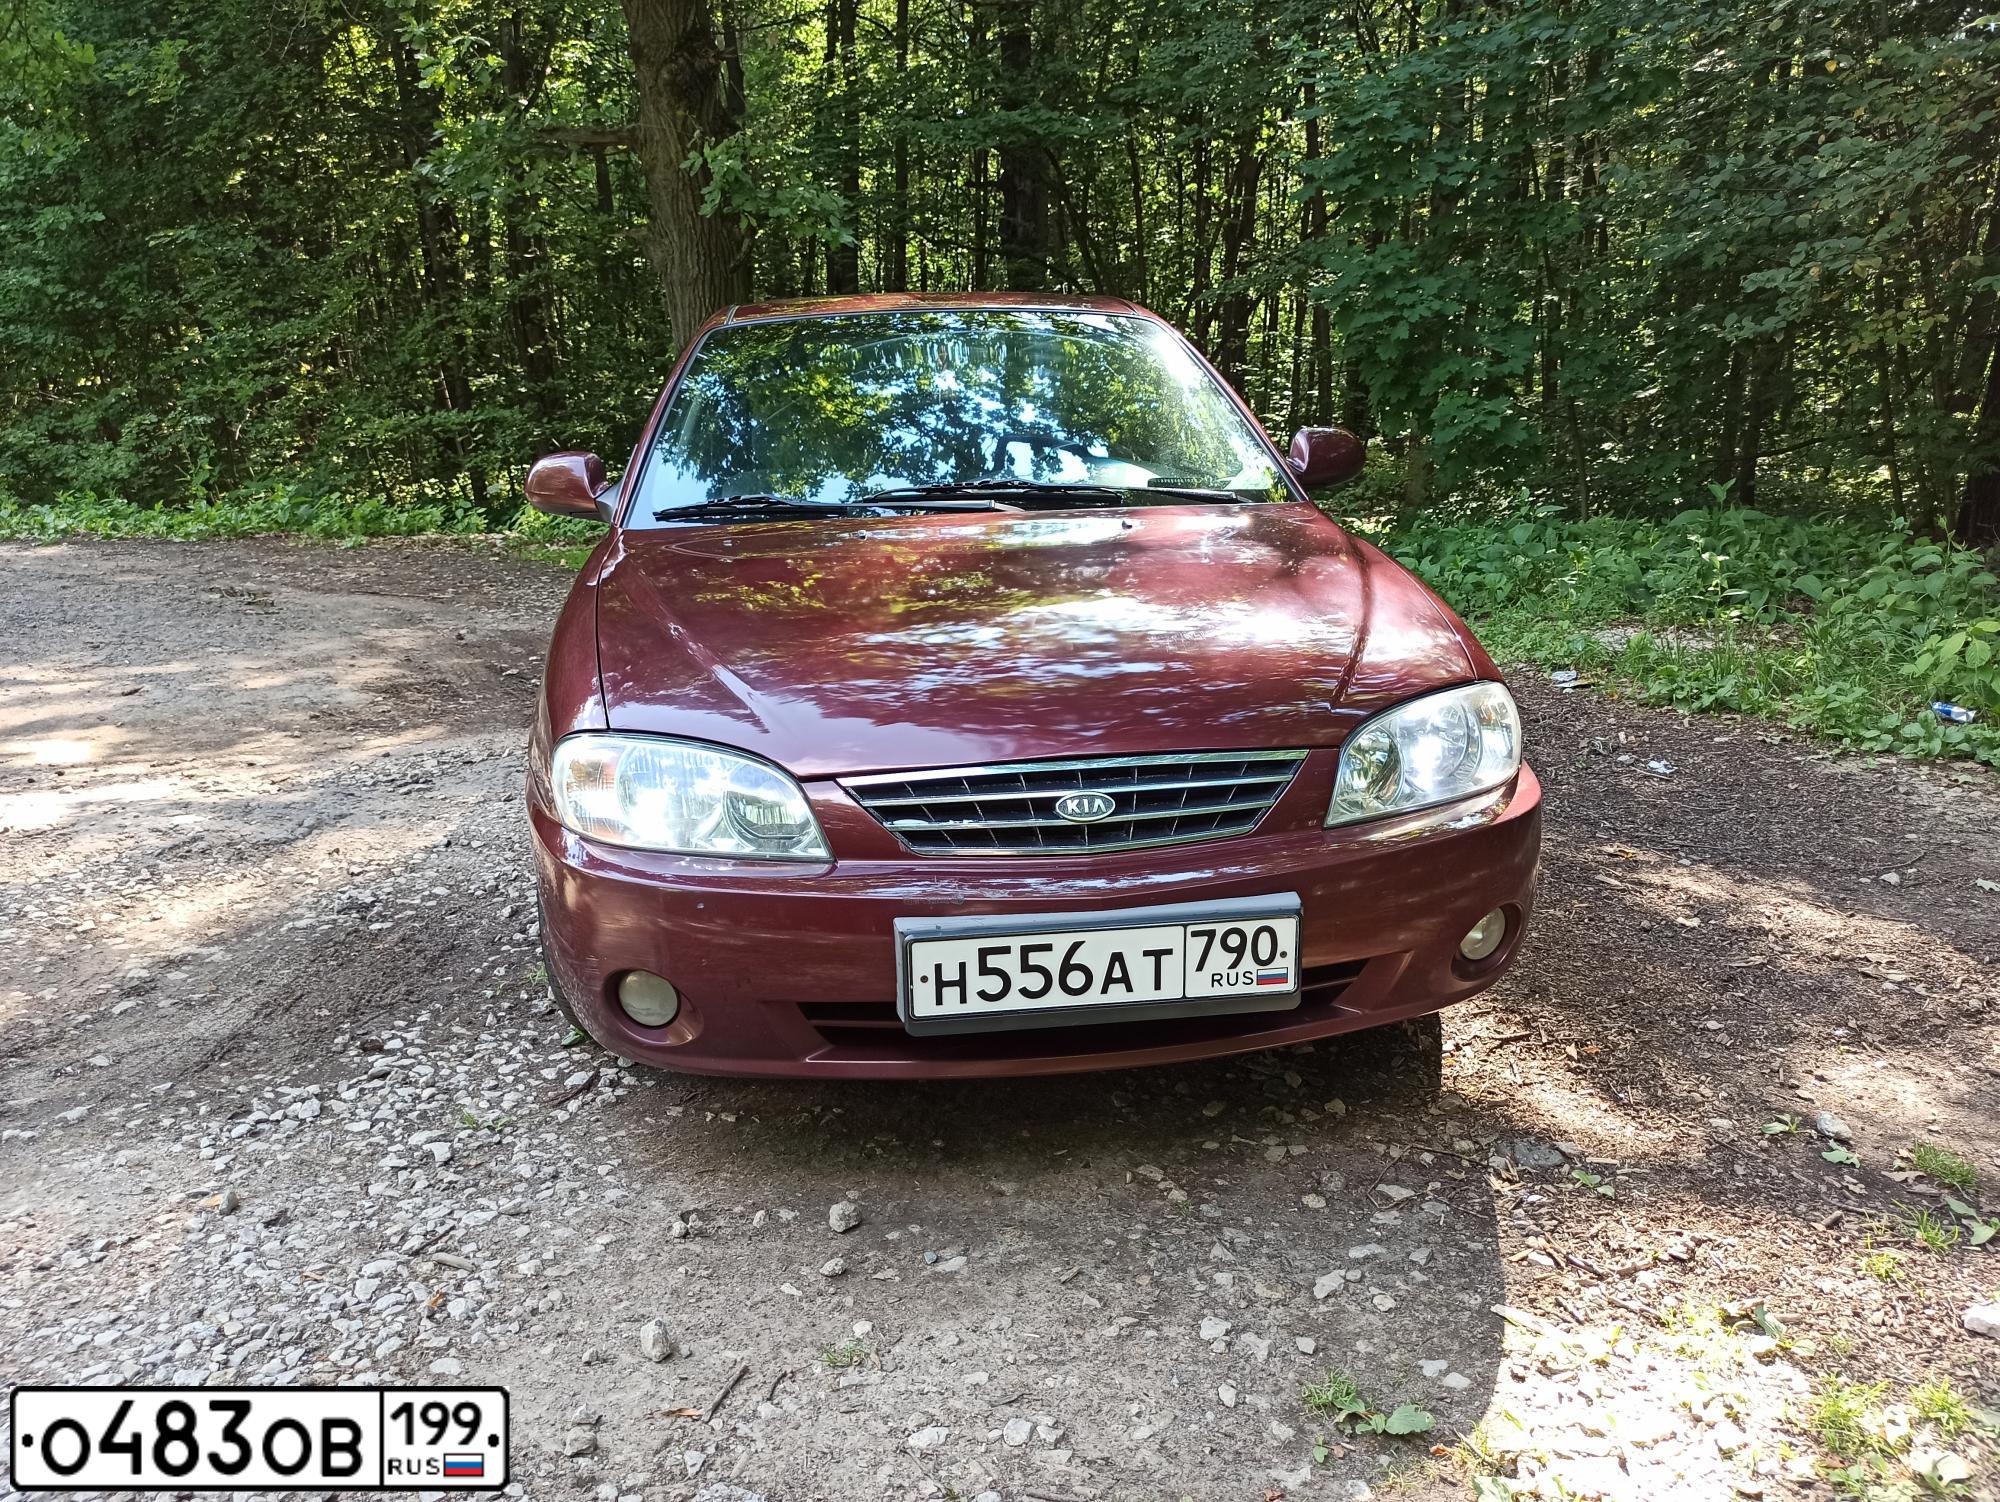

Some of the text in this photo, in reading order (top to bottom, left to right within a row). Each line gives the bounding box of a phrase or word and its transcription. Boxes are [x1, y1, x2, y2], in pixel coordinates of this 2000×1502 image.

[1066, 799, 1107, 815] KIA
[1190, 924, 1279, 973] 790
[1210, 970, 1254, 988] RUS
